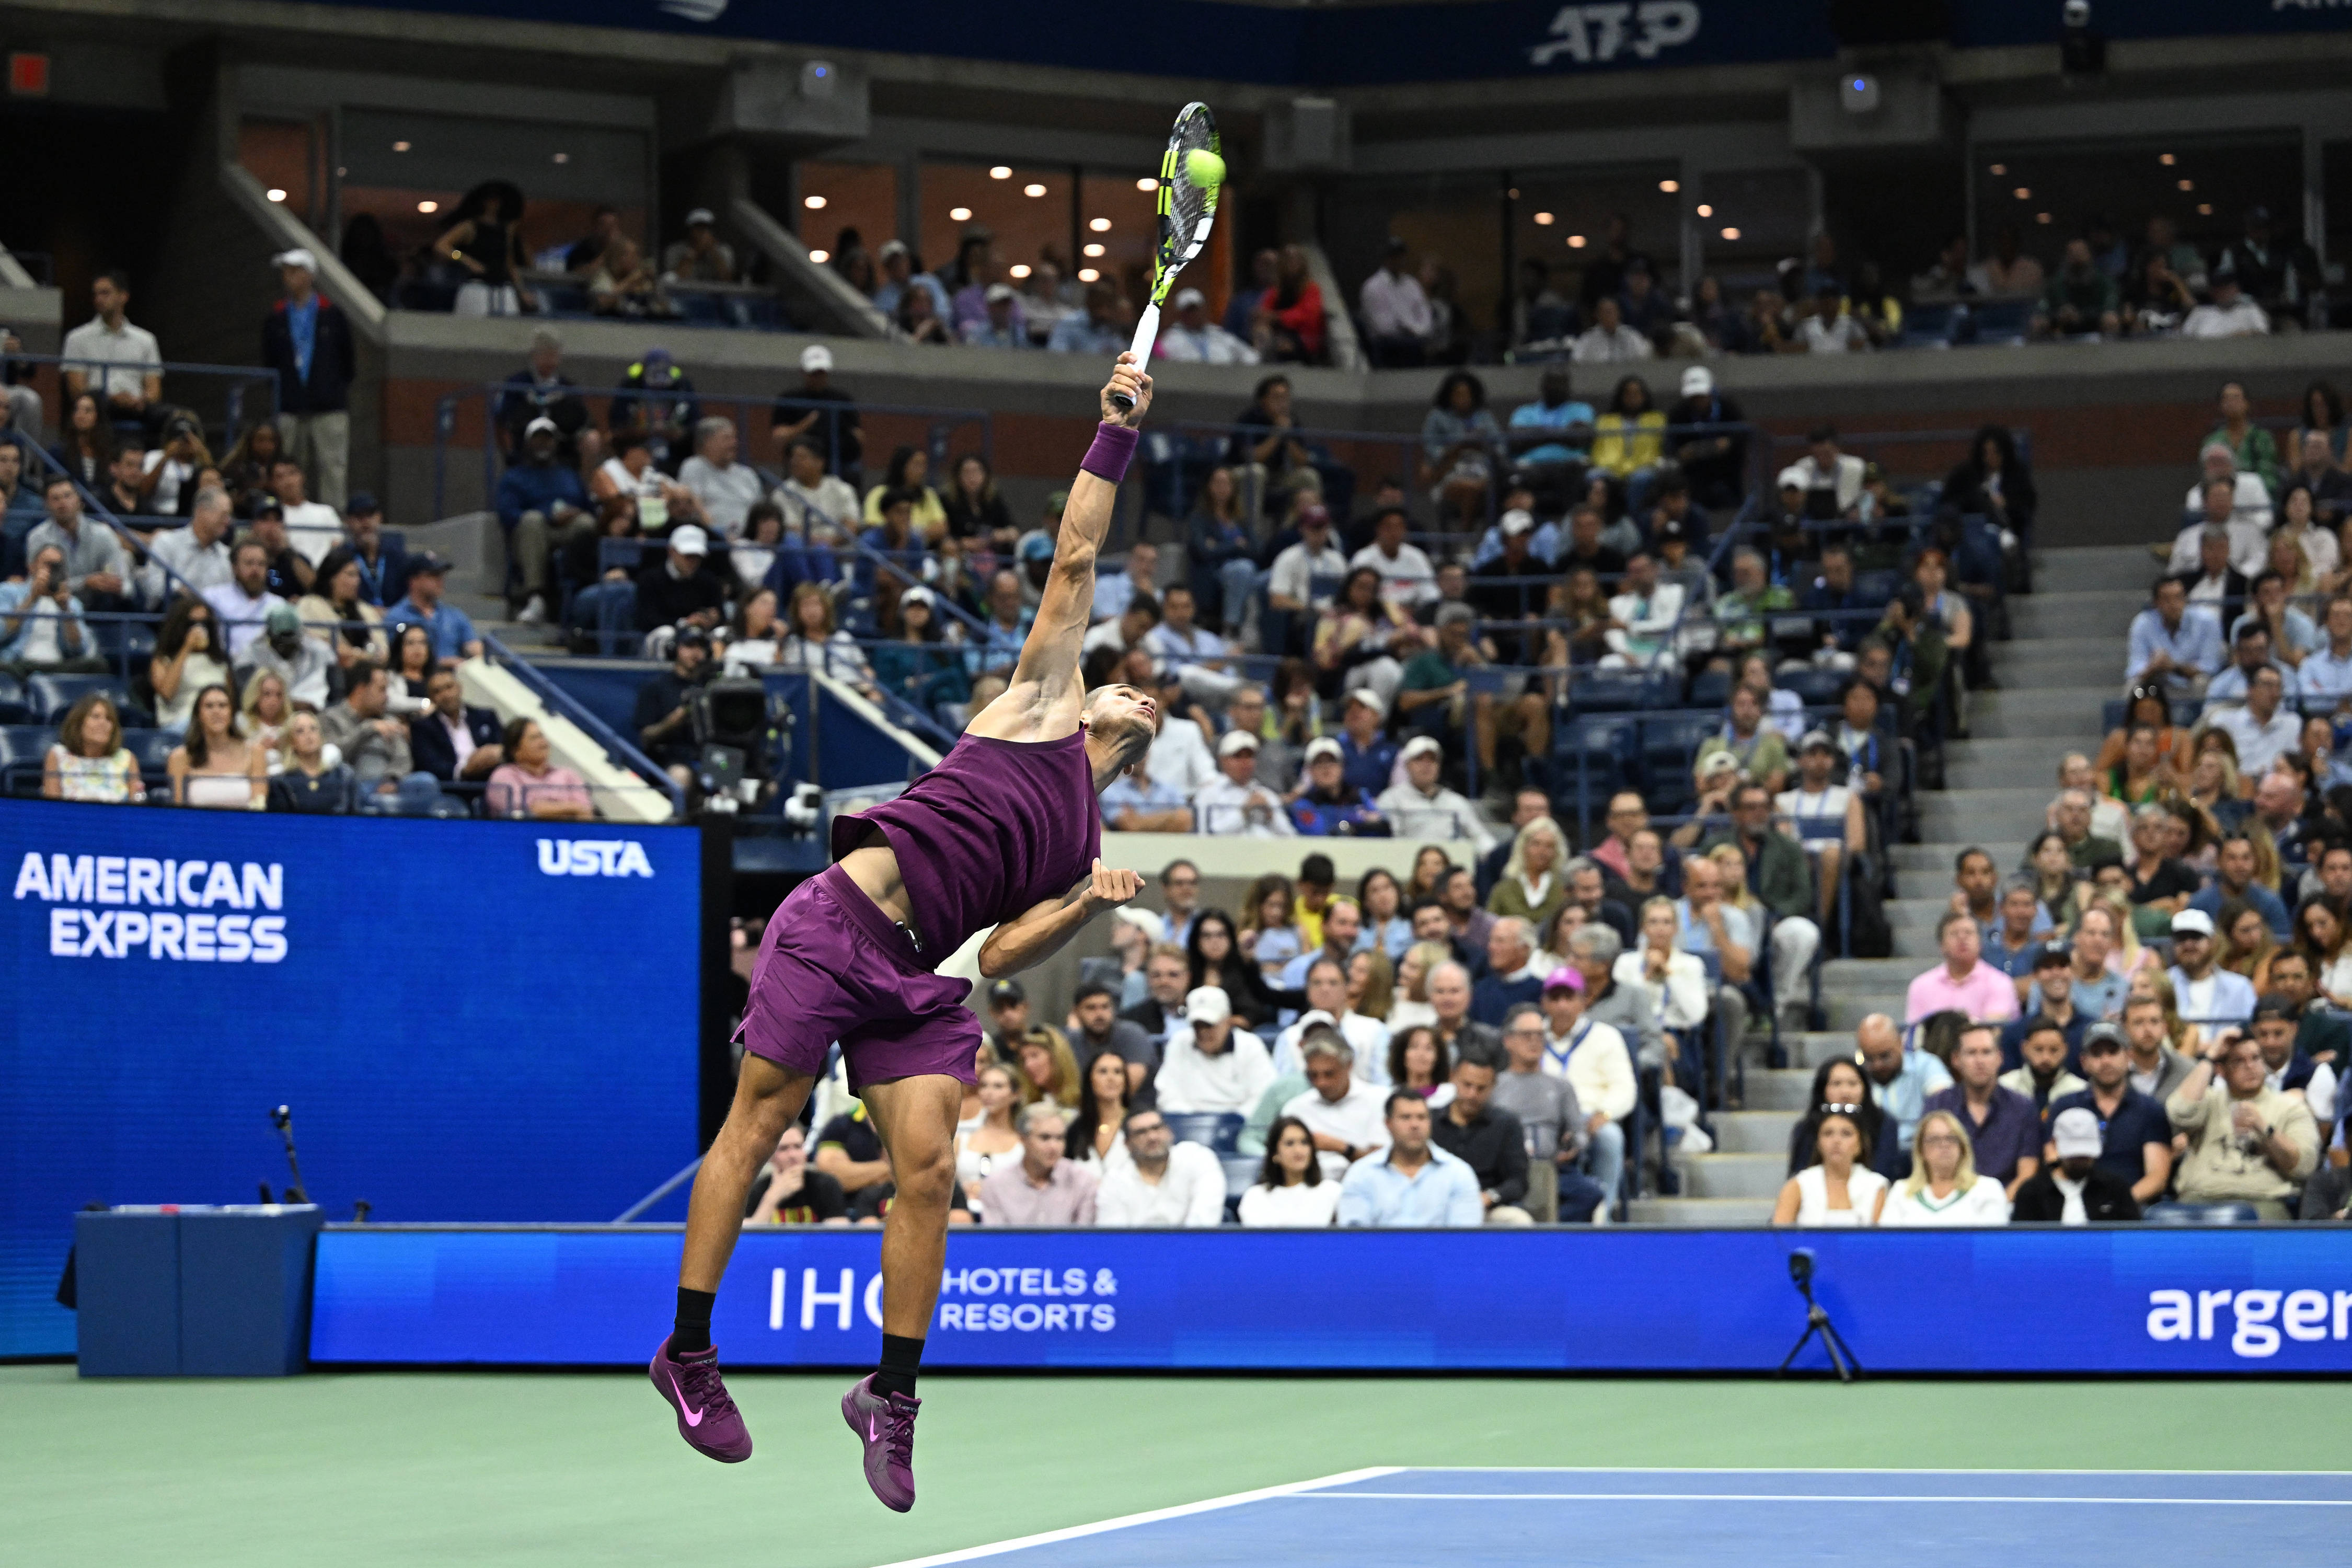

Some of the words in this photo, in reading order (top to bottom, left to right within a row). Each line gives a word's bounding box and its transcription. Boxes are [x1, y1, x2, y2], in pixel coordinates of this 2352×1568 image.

[1530, 1, 1701, 65] ATP
[14, 852, 283, 910] AMERICAN
[536, 838, 654, 878] USTA
[50, 907, 288, 963] EXPRESS
[941, 1267, 1087, 1296] HOTELS
[1092, 1267, 1117, 1296] &
[939, 1303, 1115, 1332] RESORTS
